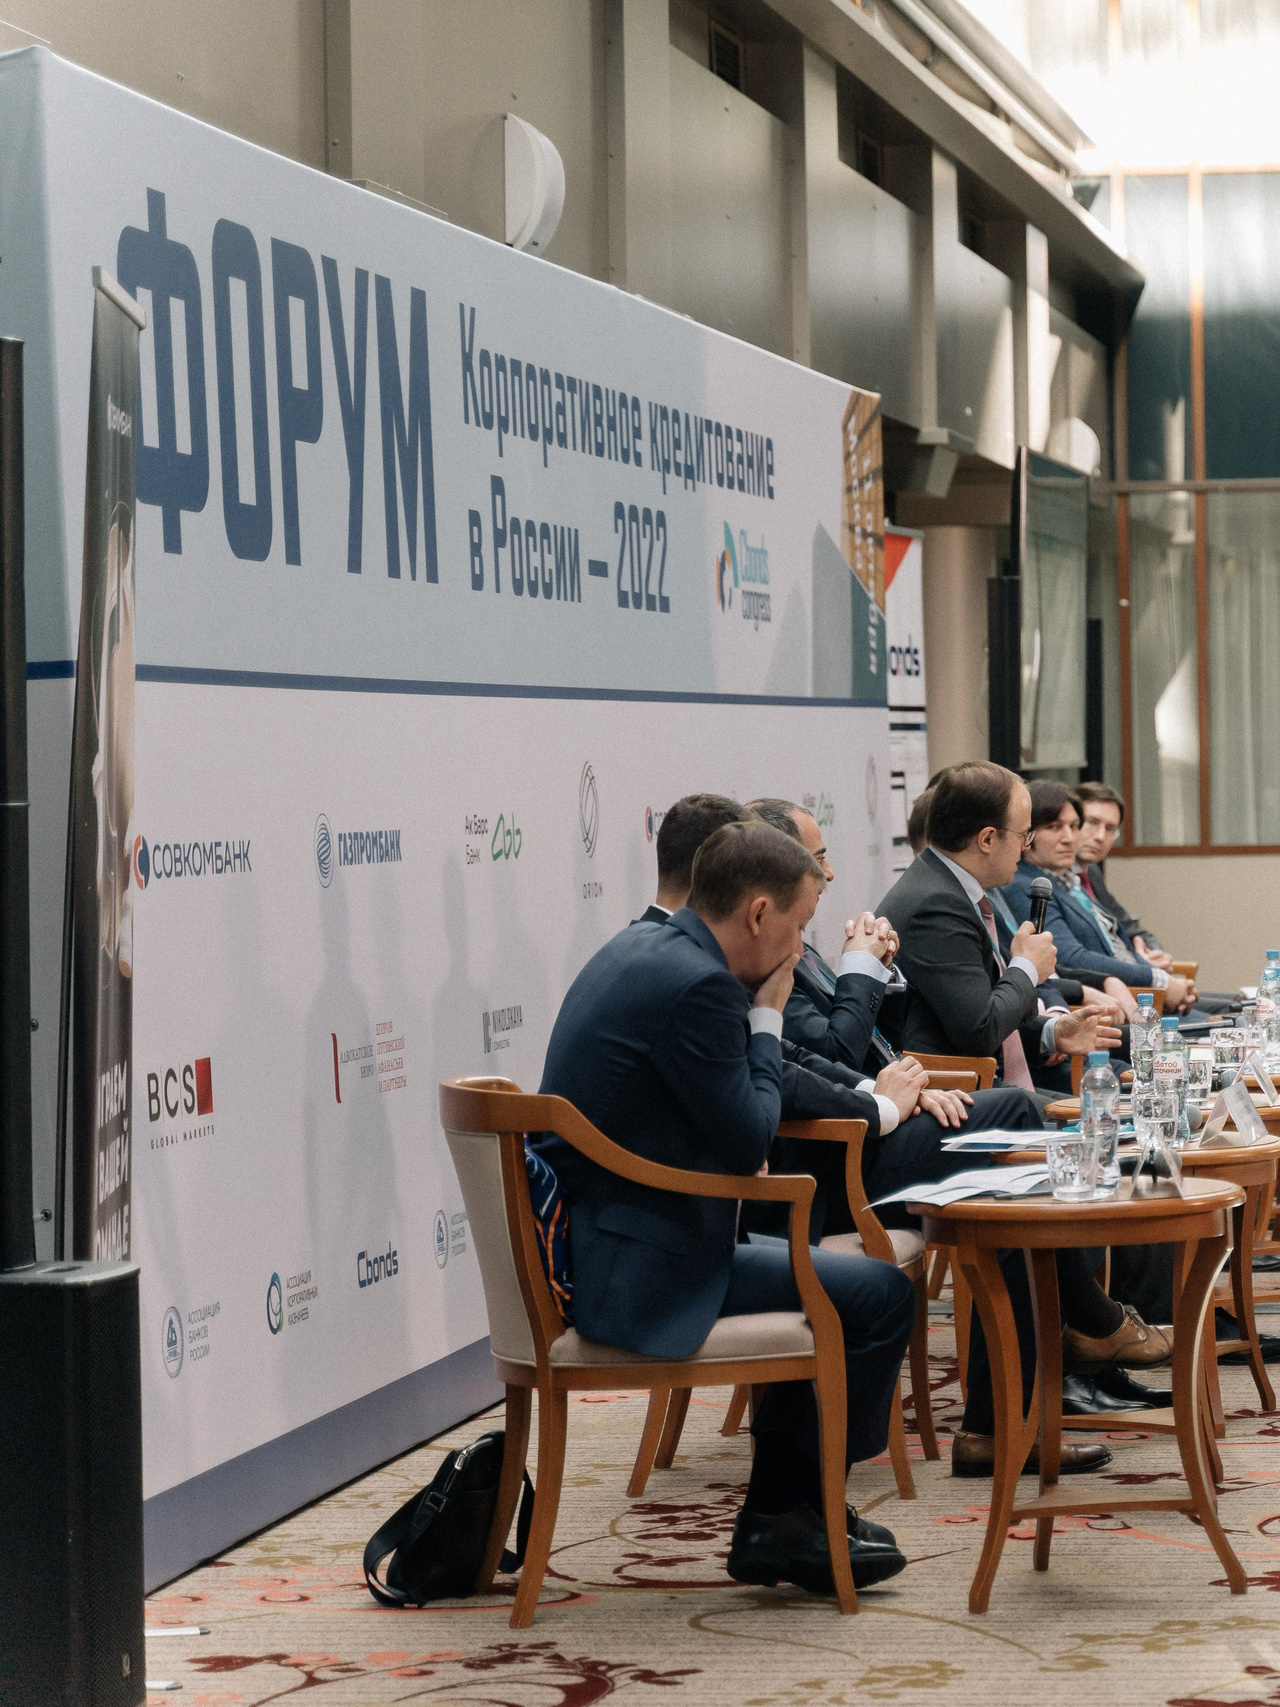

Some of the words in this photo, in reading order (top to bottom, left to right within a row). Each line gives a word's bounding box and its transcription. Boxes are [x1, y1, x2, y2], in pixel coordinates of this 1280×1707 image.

[117, 187, 439, 584] ФОРУМ
[459, 302, 642, 468] Корпоративное
[649, 401, 774, 500] кредитование
[469, 509, 485, 591] в
[490, 474, 582, 603] России
[613, 500, 670, 613] 2022
[889, 633, 920, 676] onds
[152, 839, 252, 879] СОВКОМБАНК
[338, 829, 402, 867] ГАЗПРОМБАНК
[583, 882, 603, 899] ORION
[147, 1064, 196, 1122] BCS
[150, 1135, 179, 1150] GLOBAL
[183, 1124, 216, 1141] MARKETS
[357, 1240, 398, 1288] Cbonds
[188, 1301, 220, 1325] АССОЦИАЦИЯ
[189, 1325, 208, 1344] БАНКОВ
[190, 1344, 210, 1362] РОССИИ
